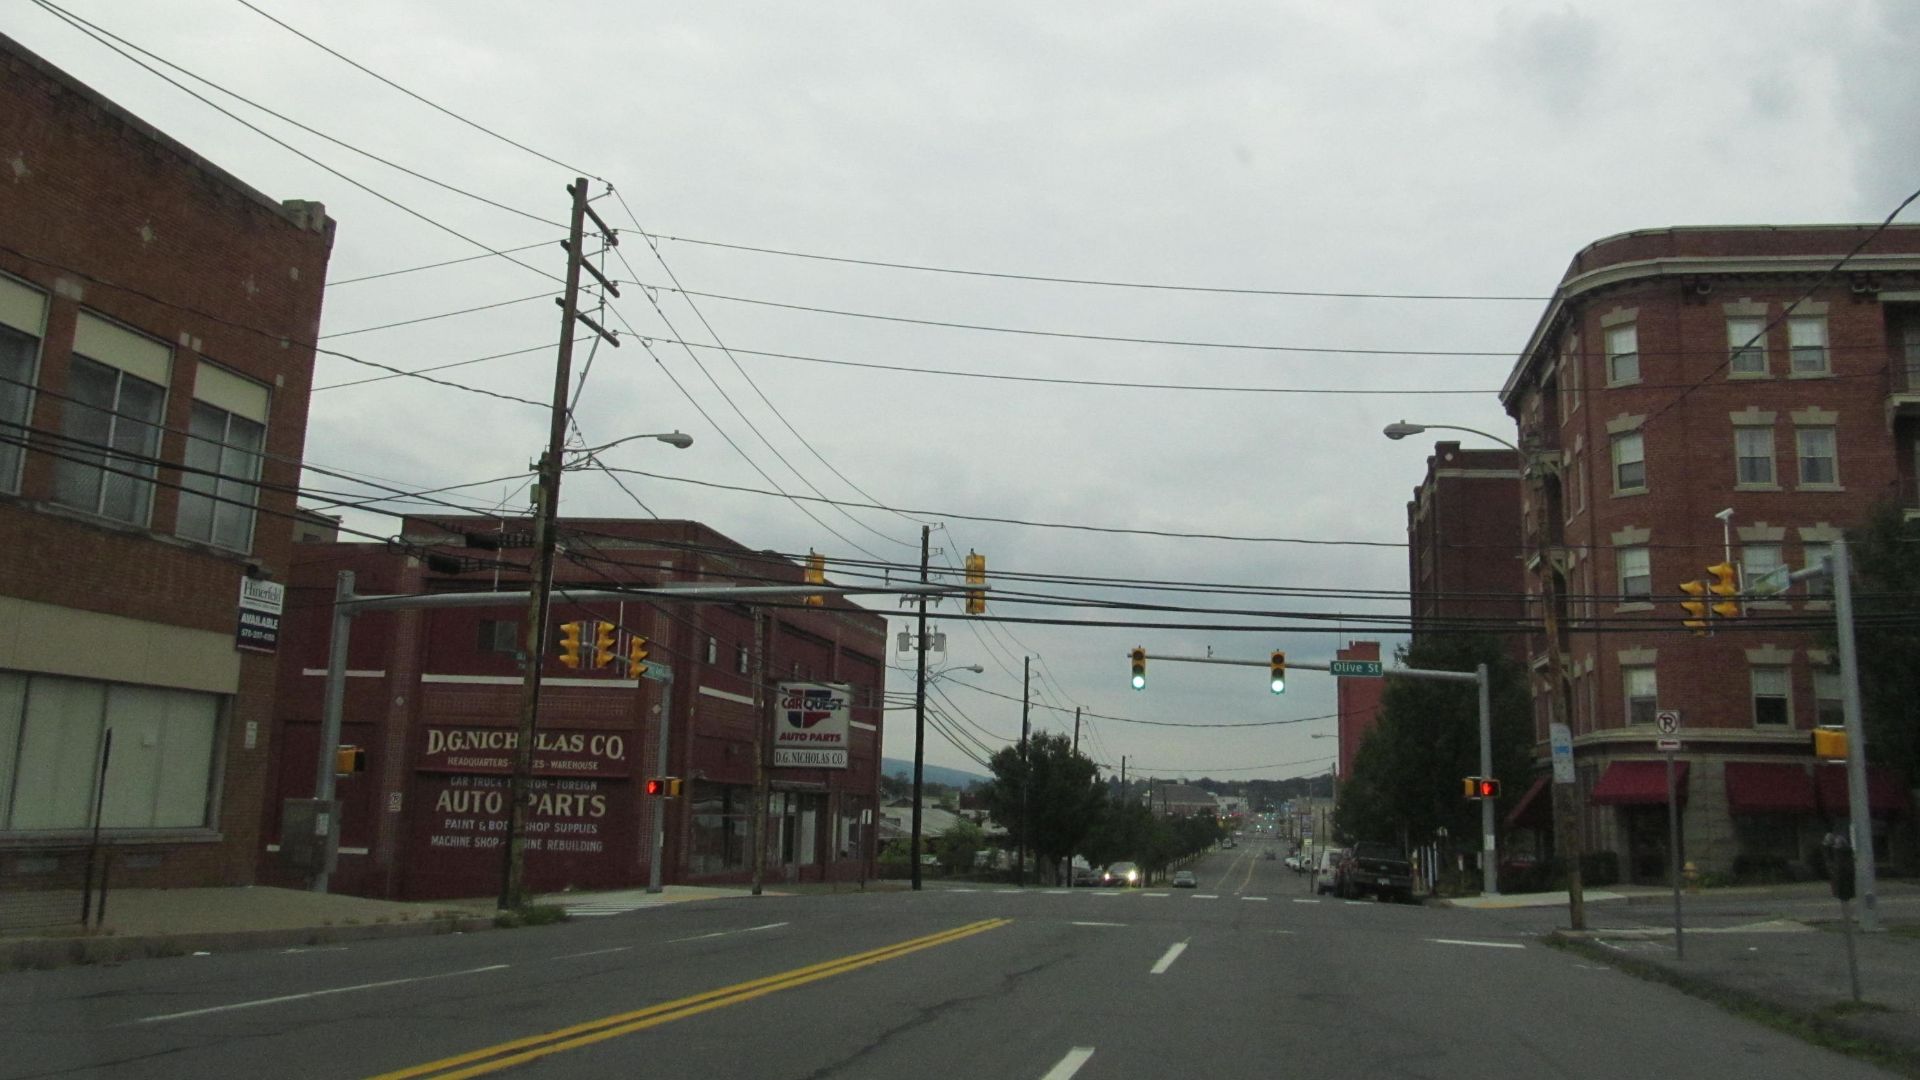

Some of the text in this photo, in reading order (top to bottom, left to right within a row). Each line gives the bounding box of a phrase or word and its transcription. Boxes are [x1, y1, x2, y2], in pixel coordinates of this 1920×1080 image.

[241, 612, 279, 630] AVAILABLE
[1334, 662, 1379, 673] Olive St
[779, 732, 841, 743] AUTO PARTS
[590, 735, 625, 760] CO.
[550, 760, 599, 770] WAREHOUSE
[792, 751, 830, 765] NICHOLAS
[832, 753, 846, 766] CO.
[450, 776, 468, 787] CAR
[435, 789, 502, 814] AUTO
[445, 819, 475, 831] PAINT
[478, 821, 486, 832] &
[554, 822, 598, 834] SUPPLIES
[431, 835, 471, 848] MACHINE
[547, 839, 603, 853] REBUILDING
